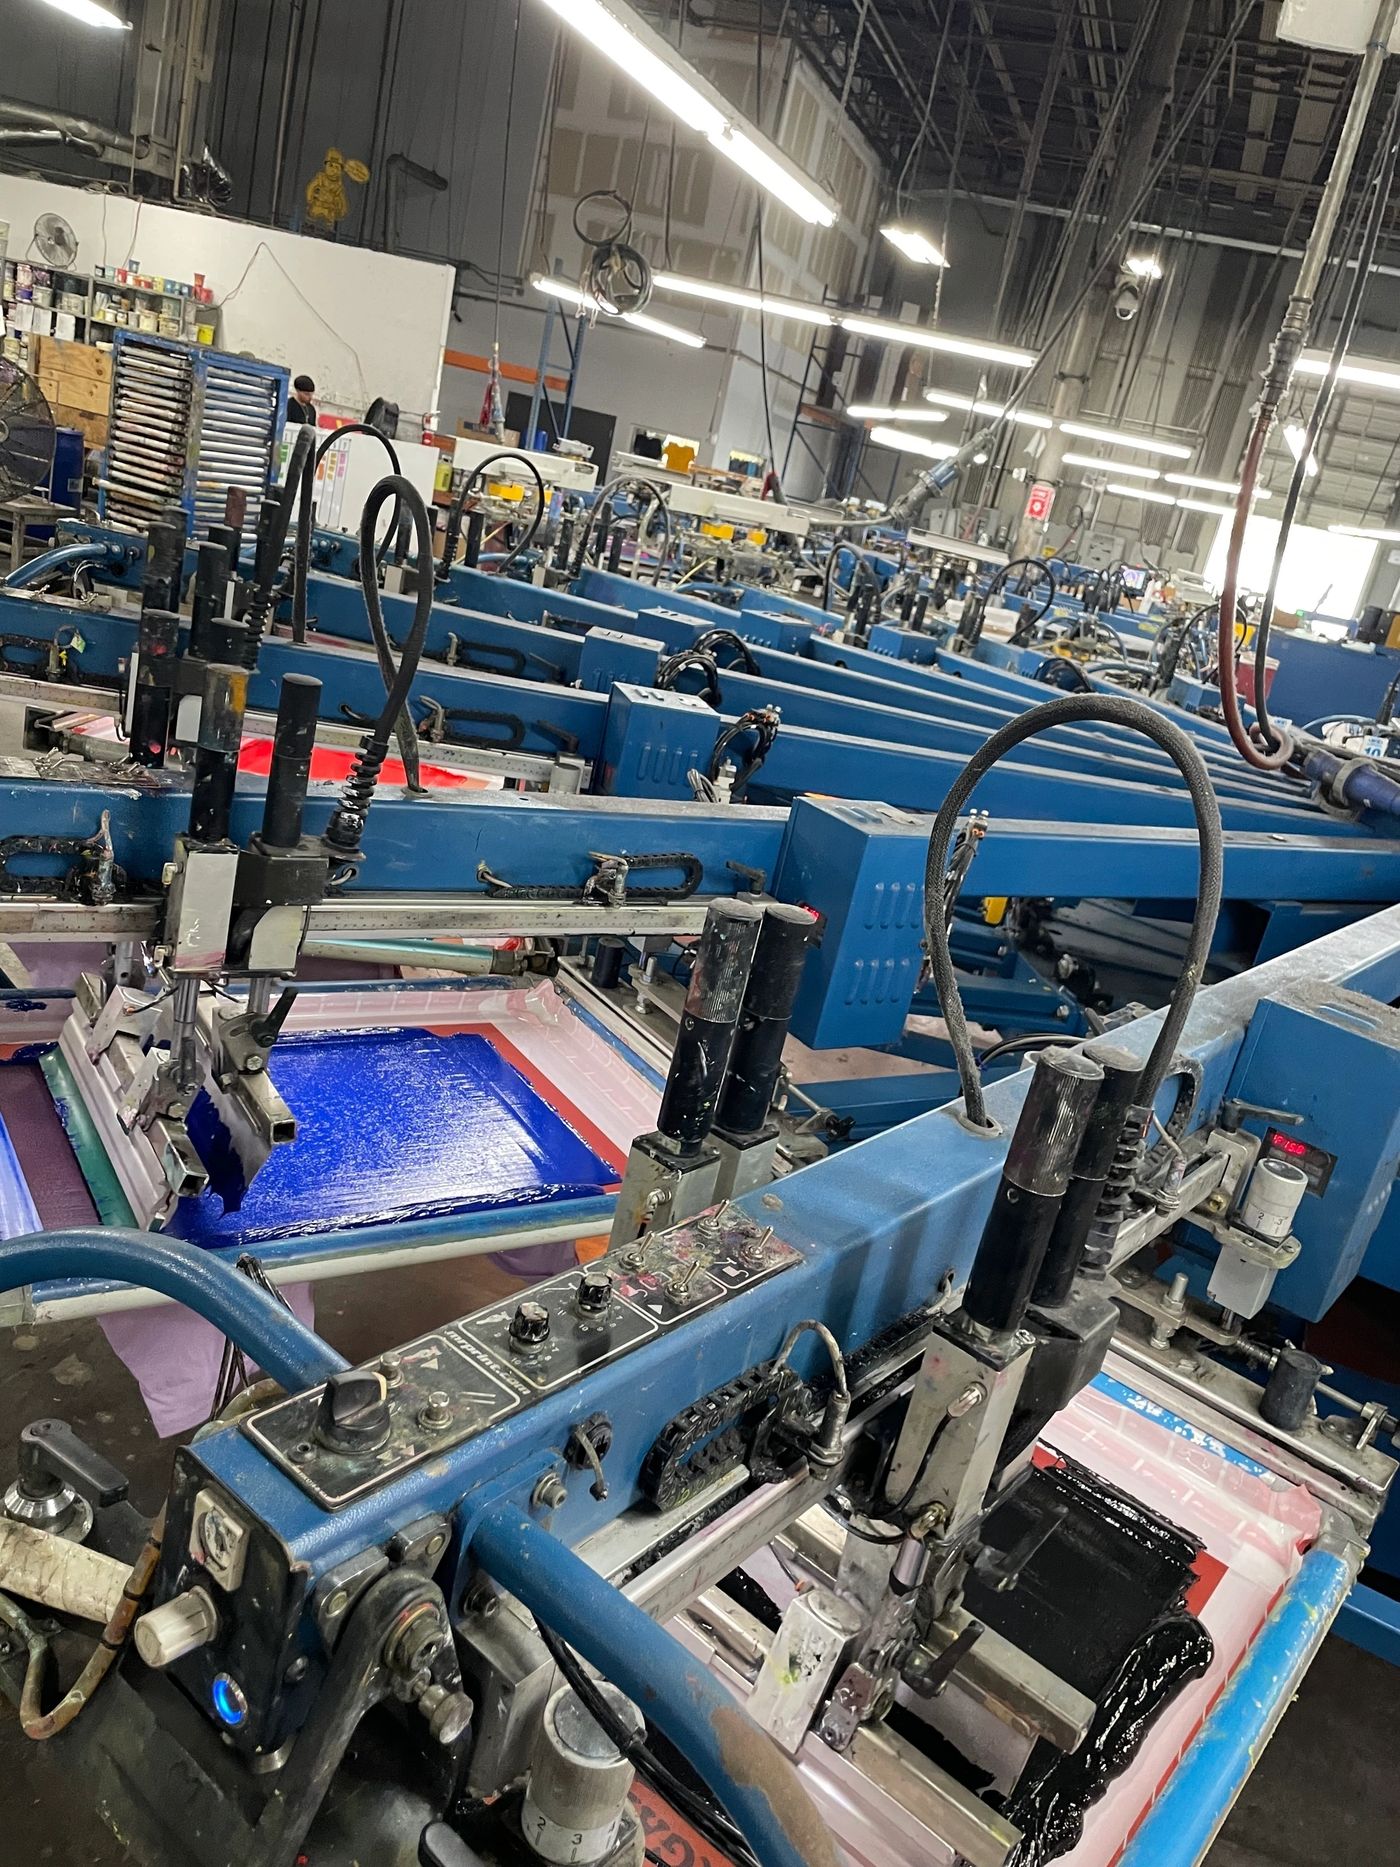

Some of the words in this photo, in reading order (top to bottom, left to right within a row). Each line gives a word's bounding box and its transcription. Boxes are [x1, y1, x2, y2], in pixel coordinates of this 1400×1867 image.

[1258, 1211, 1265, 1220] 2
[579, 1324, 589, 1332] 10
[443, 1330, 531, 1395] mrprint.com
[537, 1816, 546, 1831] 2
[571, 1833, 583, 1845] 3
